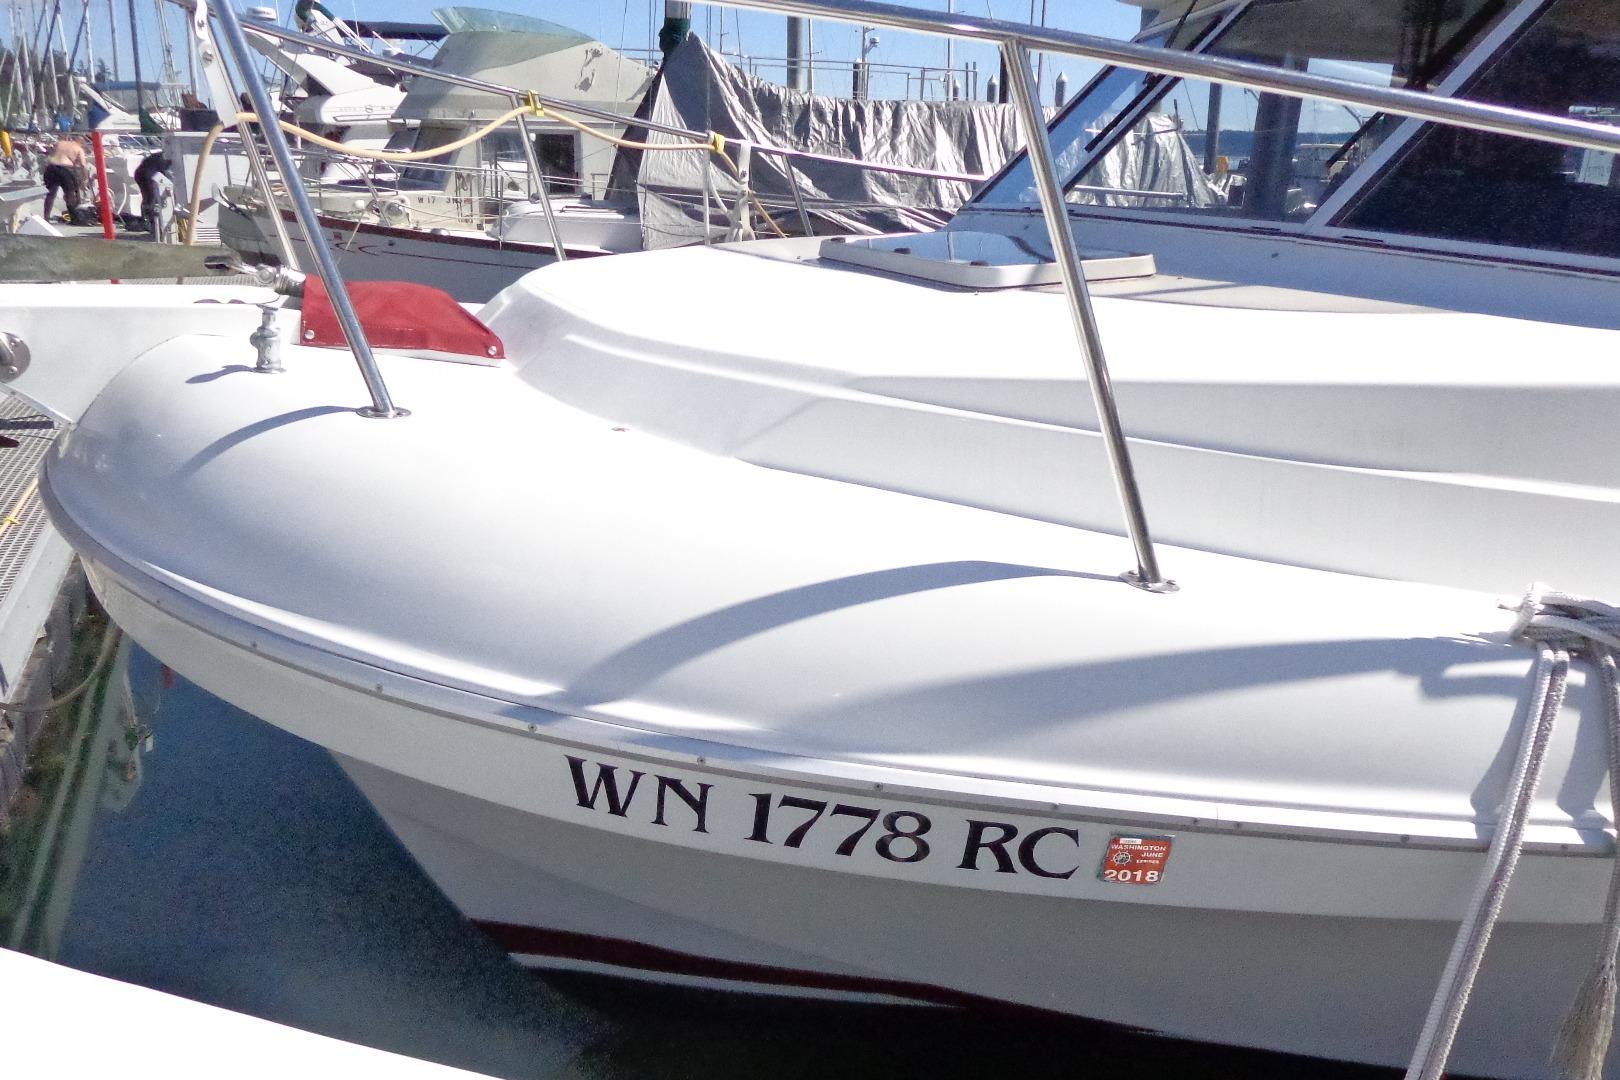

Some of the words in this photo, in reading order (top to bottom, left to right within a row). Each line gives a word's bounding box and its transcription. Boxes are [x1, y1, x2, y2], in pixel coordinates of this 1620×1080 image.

[563, 754, 715, 834] WN
[744, 792, 932, 863] 1778
[956, 818, 1080, 880] RC
[1104, 869, 1159, 882] 2018
